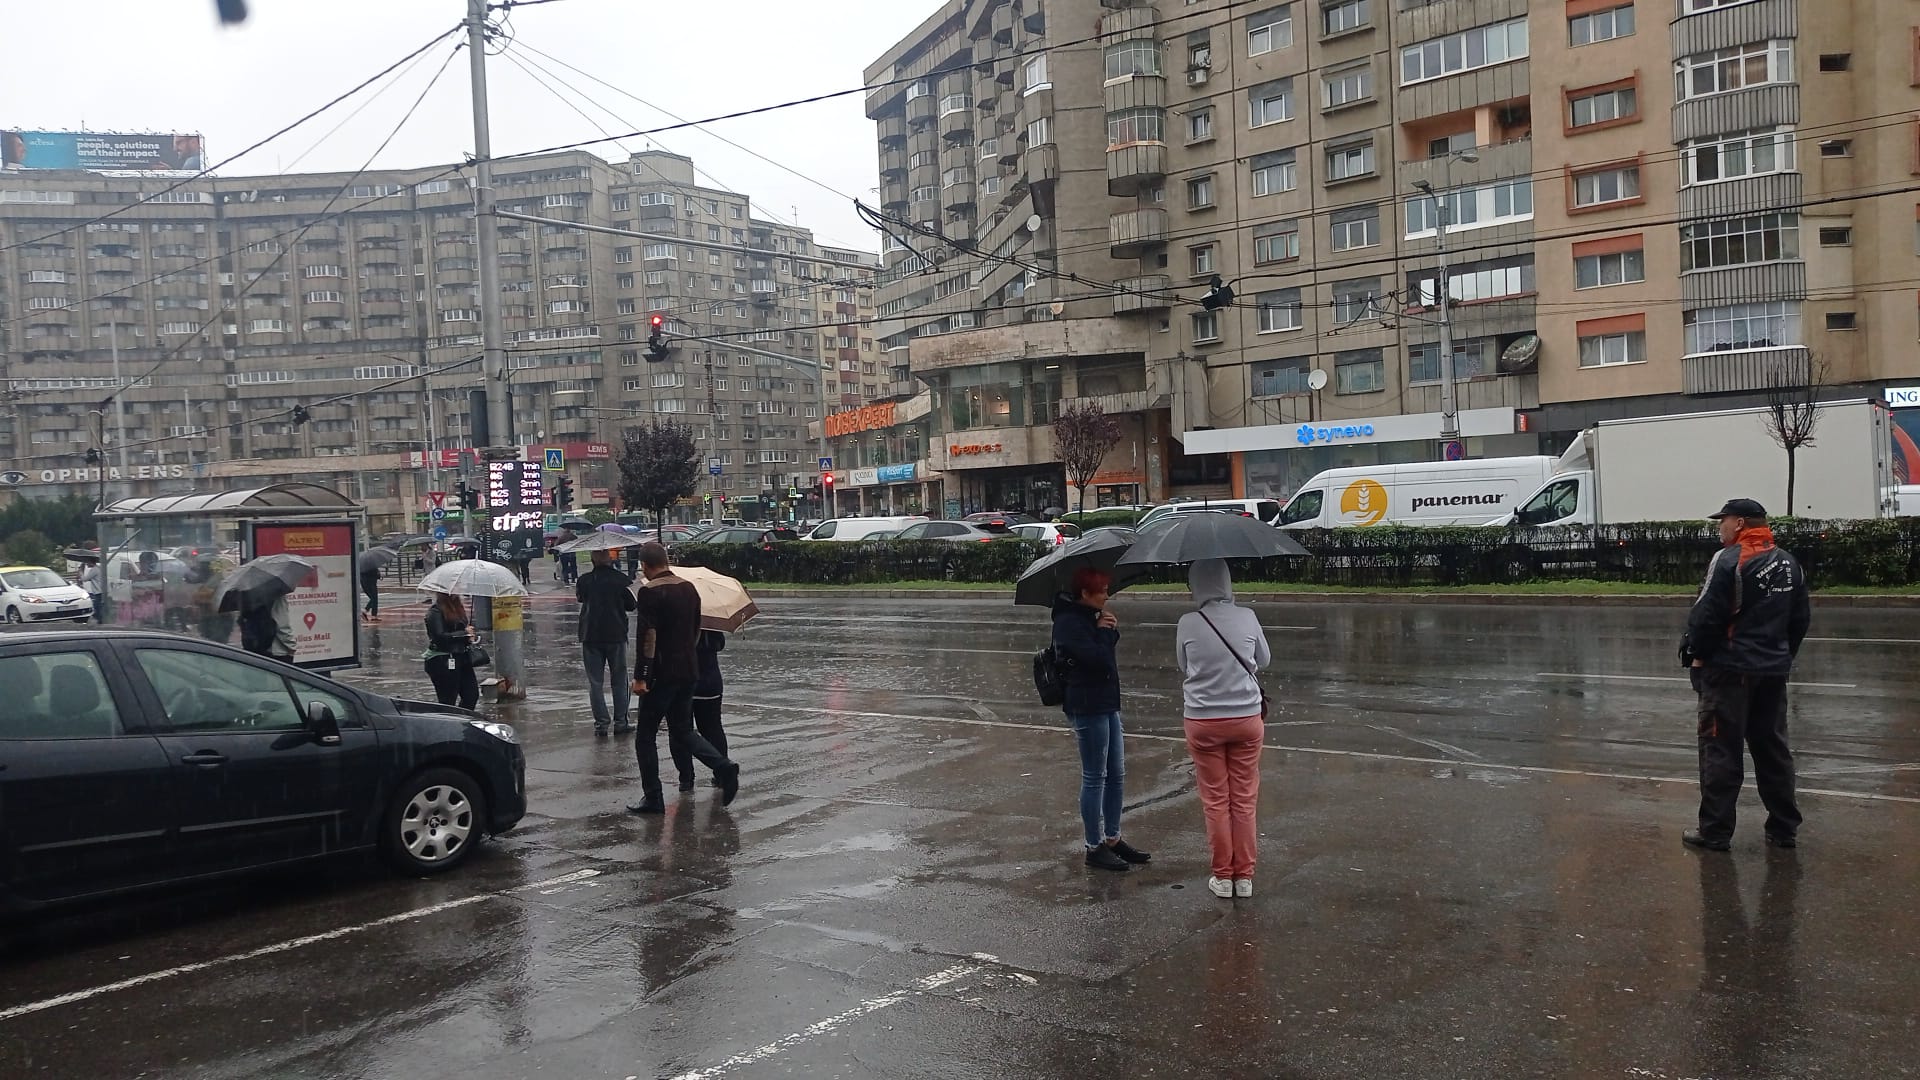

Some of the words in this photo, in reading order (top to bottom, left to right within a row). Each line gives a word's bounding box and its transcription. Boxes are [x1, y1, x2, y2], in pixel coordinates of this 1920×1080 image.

[77, 141, 113, 150] people,
[114, 141, 160, 149] solutions
[123, 149, 160, 158] impact.
[1890, 391, 1918, 403] ING
[824, 401, 896, 437] MOBEXPERT
[1317, 424, 1374, 442] synevo
[522, 462, 541, 470] 1min
[40, 465, 183, 483] OPHTAENS
[522, 471, 541, 479] 1min
[520, 497, 541, 505] 4min
[1411, 494, 1504, 512] panemar
